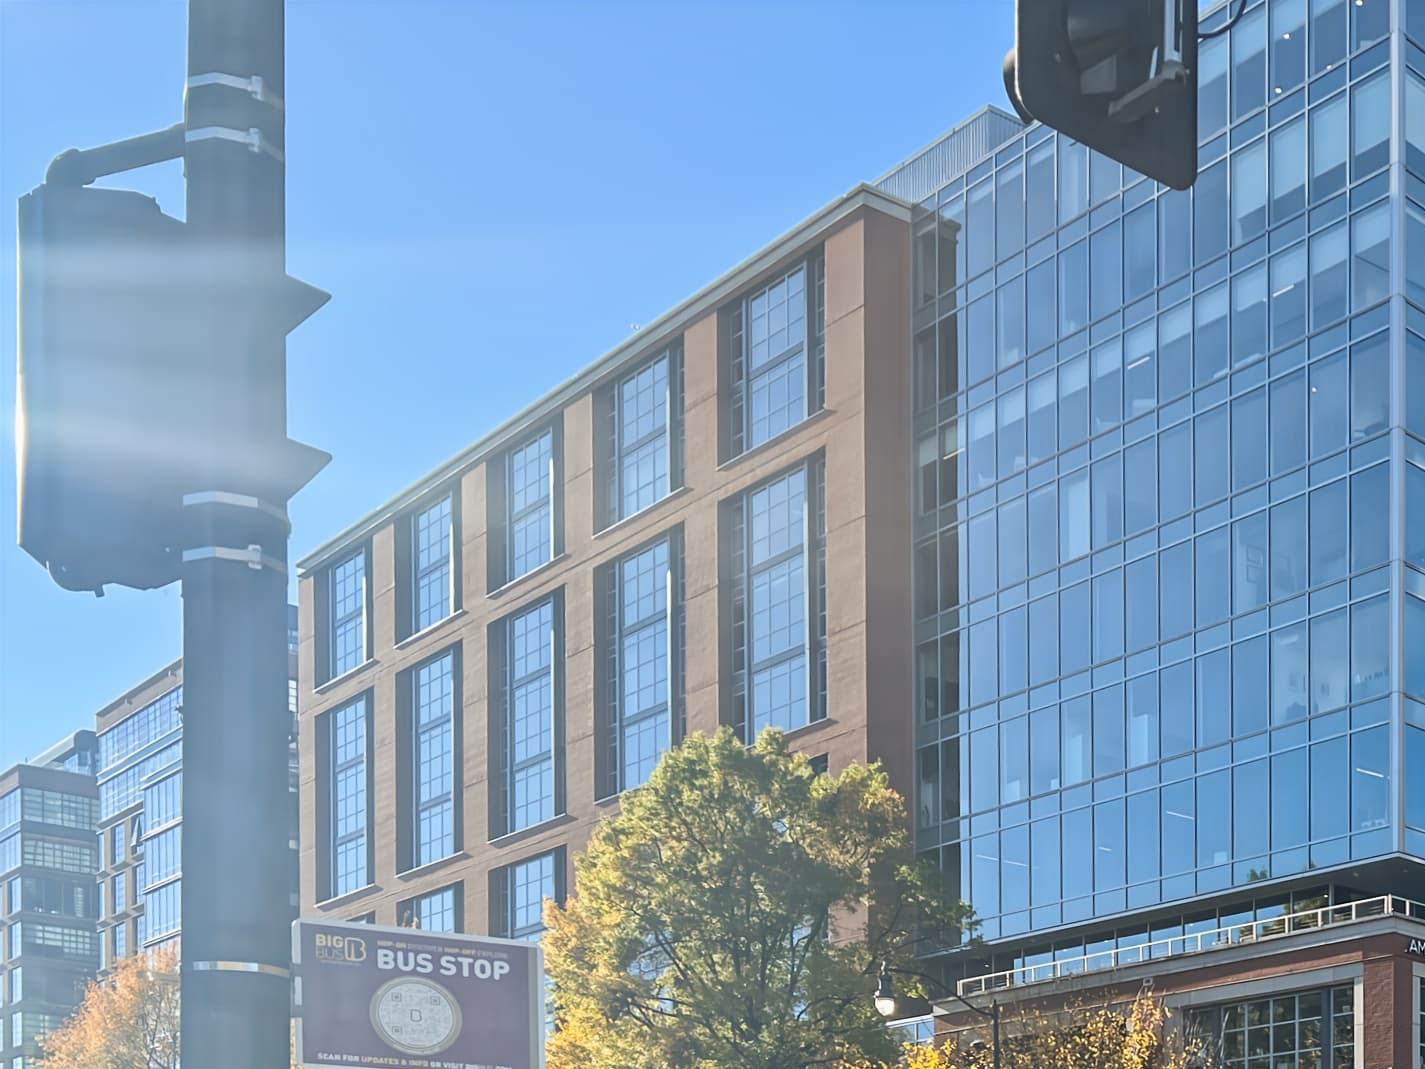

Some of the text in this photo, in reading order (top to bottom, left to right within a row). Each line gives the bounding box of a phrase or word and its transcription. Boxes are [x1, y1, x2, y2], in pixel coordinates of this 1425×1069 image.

[315, 933, 344, 948] BIG
[377, 948, 511, 980] BUS STOP
